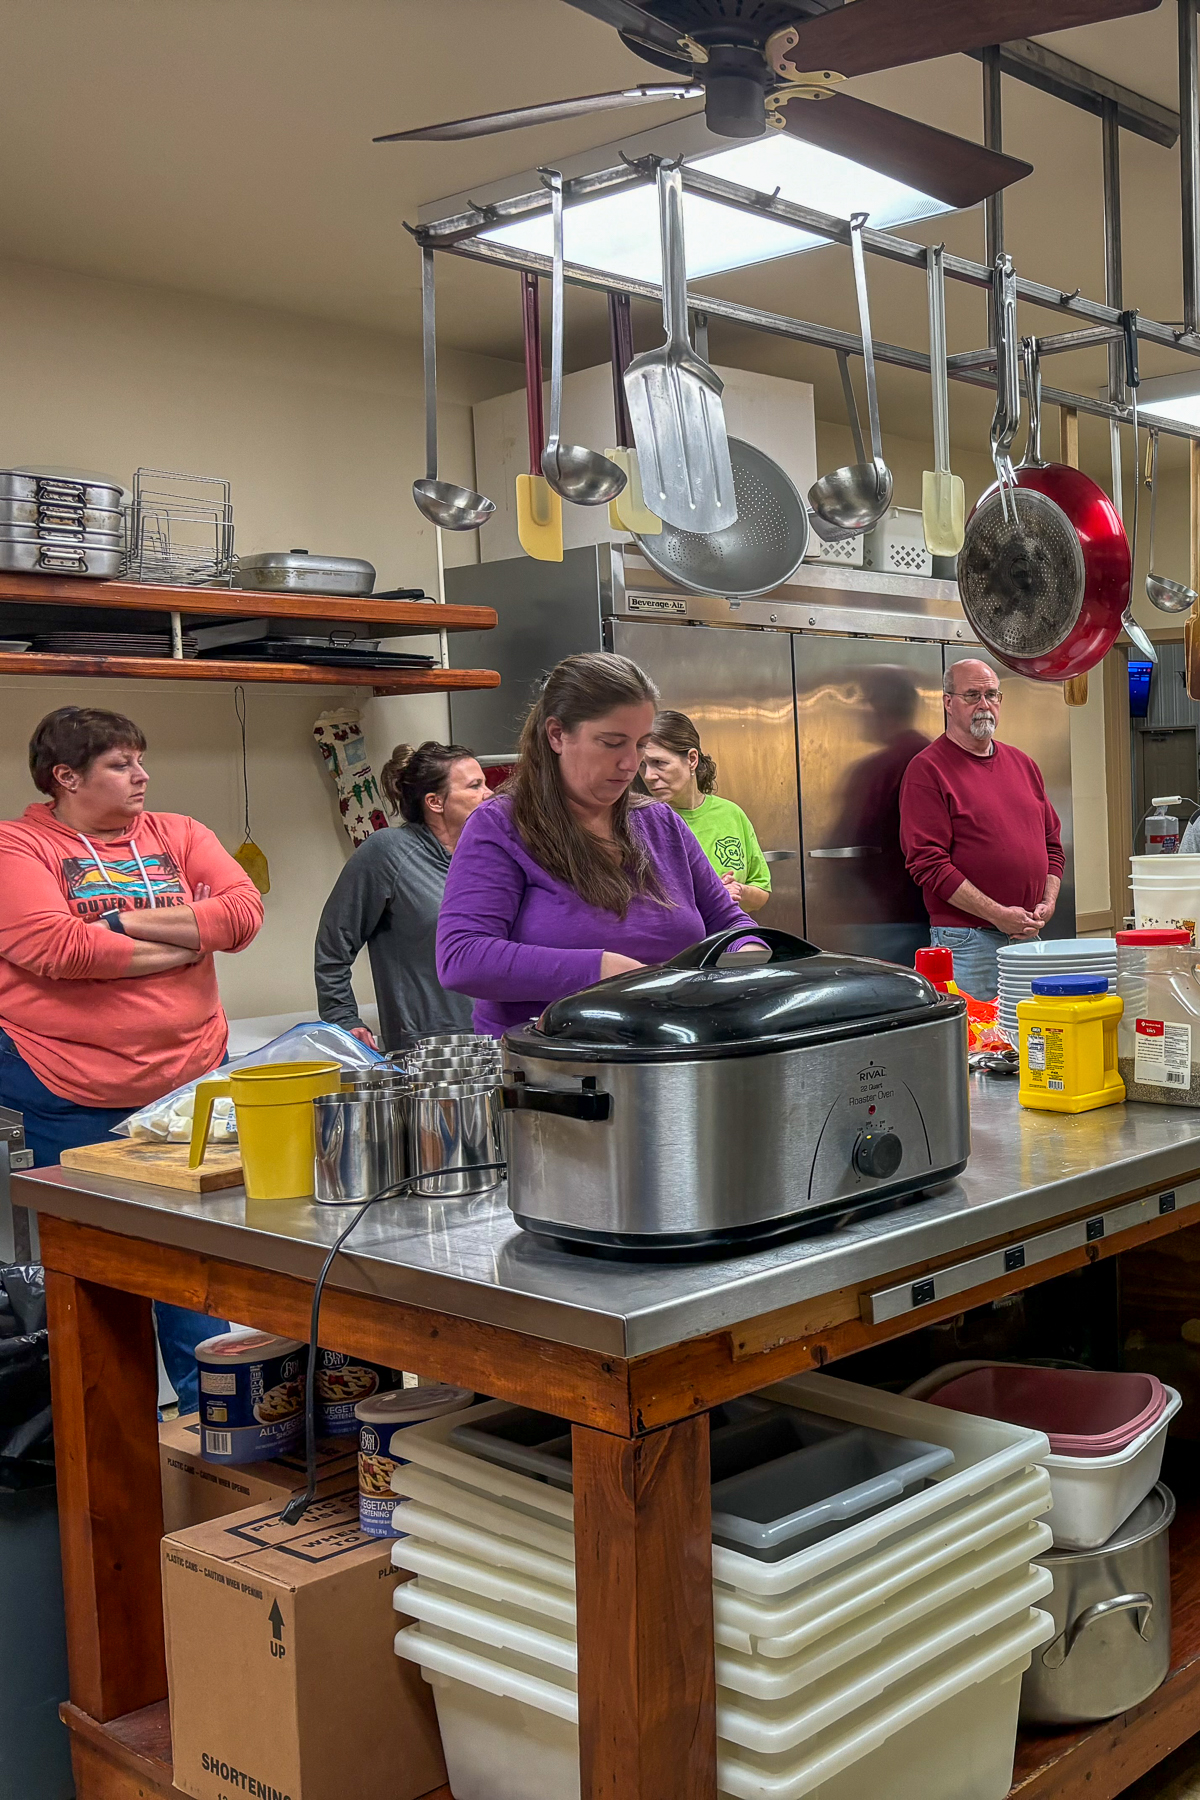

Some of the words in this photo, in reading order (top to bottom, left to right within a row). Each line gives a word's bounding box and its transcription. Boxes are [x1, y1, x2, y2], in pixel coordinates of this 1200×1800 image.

[728, 848, 739, 857] 64
[76, 896, 127, 914] OUTER
[859, 1069, 886, 1081] RIVAL
[868, 1082, 883, 1090] Quart
[849, 1094, 876, 1106] Roaster
[878, 1090, 894, 1100] Oven
[322, 1404, 355, 1415] VEGET
[259, 1426, 278, 1437] ALL
[167, 1457, 184, 1471] PLASTIC
[184, 1463, 195, 1475] CANS
[200, 1470, 218, 1484] CAUTION
[218, 1477, 231, 1490] WHEN
[231, 1481, 250, 1496] OPENING
[303, 1508, 346, 1523] USE
[329, 1535, 360, 1547] TO
[166, 1552, 185, 1567] PLASTIC
[185, 1560, 198, 1573] CANS
[204, 1567, 225, 1585] CAUTION
[226, 1576, 241, 1591] WHEN
[241, 1583, 263, 1600] OPENING
[270, 1640, 286, 1659] UP
[201, 1752, 292, 1800] SHORTENIN
